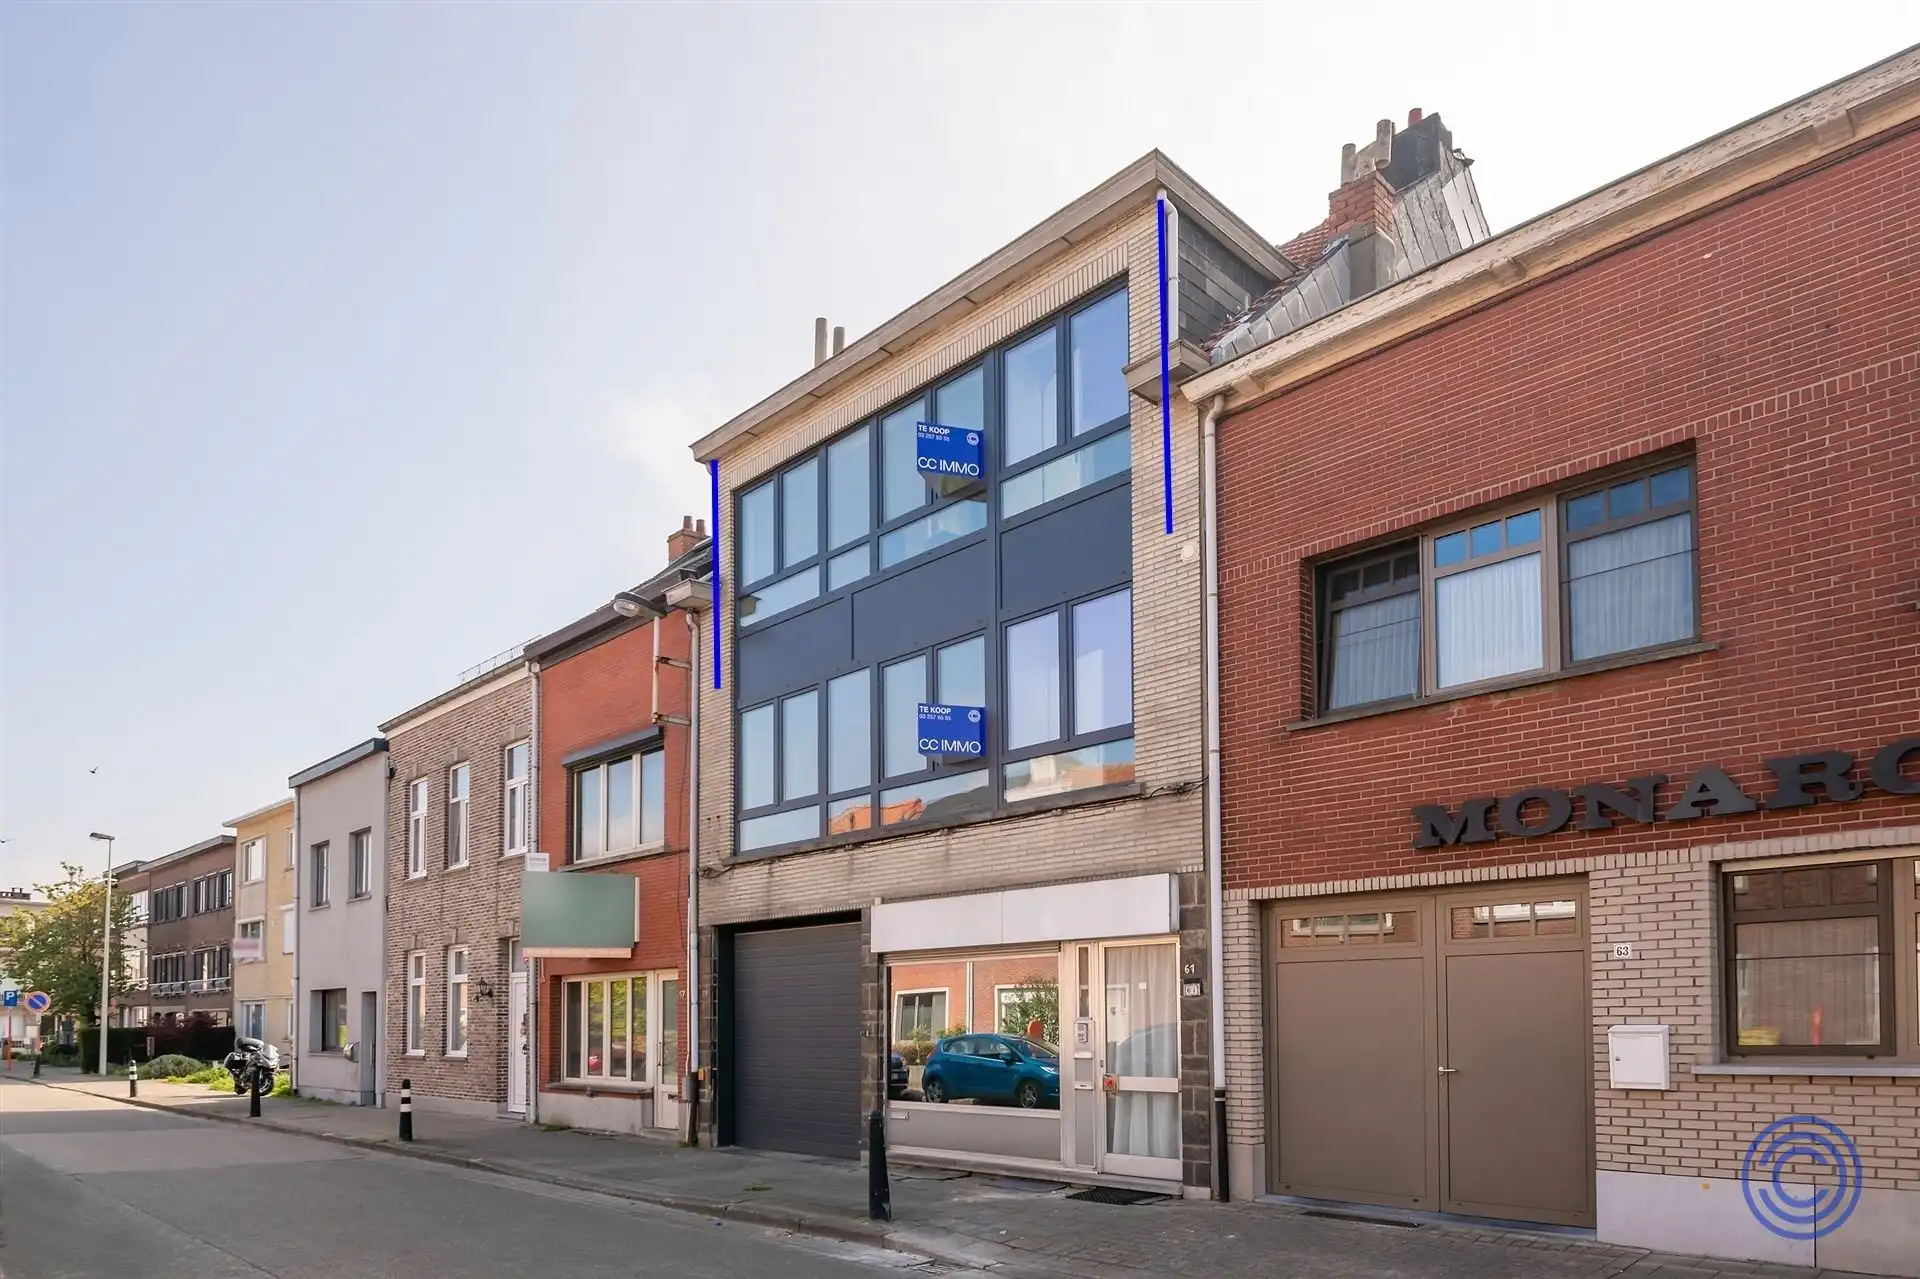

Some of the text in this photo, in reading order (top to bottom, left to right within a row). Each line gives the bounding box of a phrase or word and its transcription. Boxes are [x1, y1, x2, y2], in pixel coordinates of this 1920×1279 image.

[918, 424, 950, 435] TE KOOP
[918, 457, 980, 476] CC IMMO
[930, 706, 952, 714] KOOP
[919, 738, 982, 753] CC IMMO
[1616, 945, 1629, 956] 63
[6, 991, 16, 1001] P
